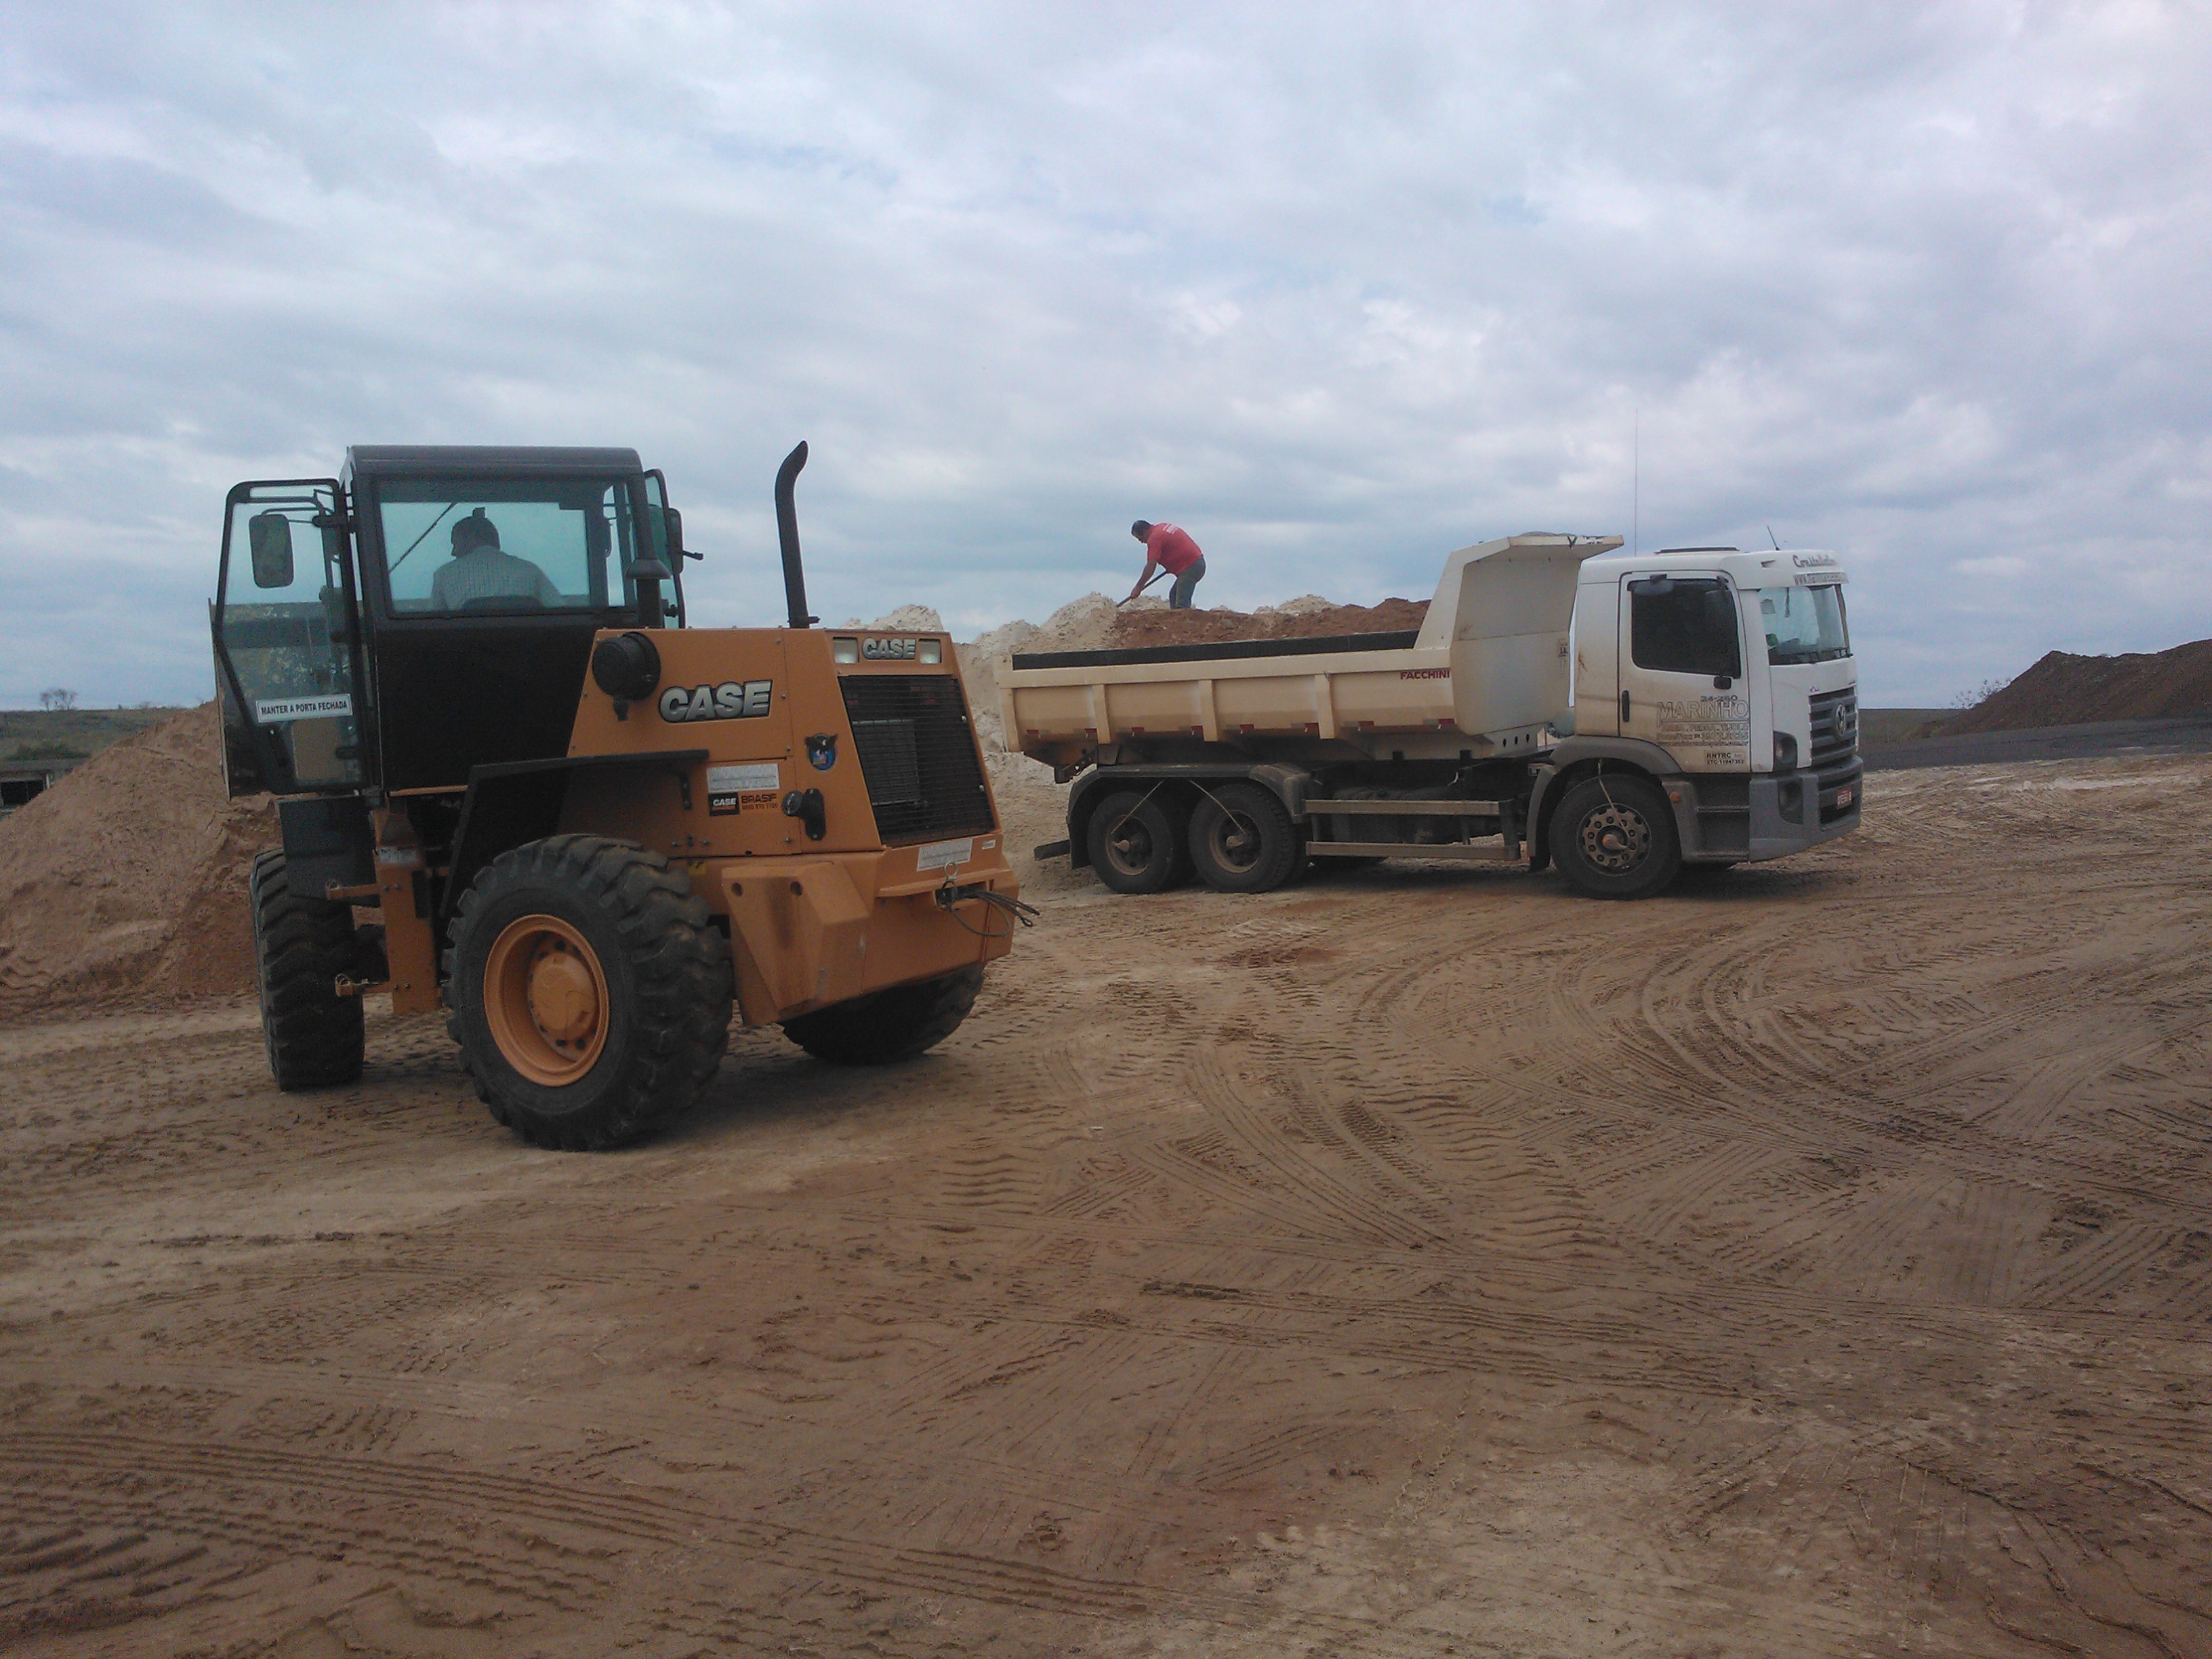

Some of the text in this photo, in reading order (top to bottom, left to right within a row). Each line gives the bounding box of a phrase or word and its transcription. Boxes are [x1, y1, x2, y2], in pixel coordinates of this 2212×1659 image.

[862, 637, 916, 659] CASE
[1400, 670, 1450, 680] FACCHINI
[261, 705, 288, 715] MANTER
[296, 703, 317, 712] PORTA
[319, 700, 348, 711] FECHADA
[659, 680, 773, 722] CASE
[1657, 700, 1748, 723] MARINHO
[713, 798, 737, 806] CASE
[741, 793, 777, 804] BRASIF
